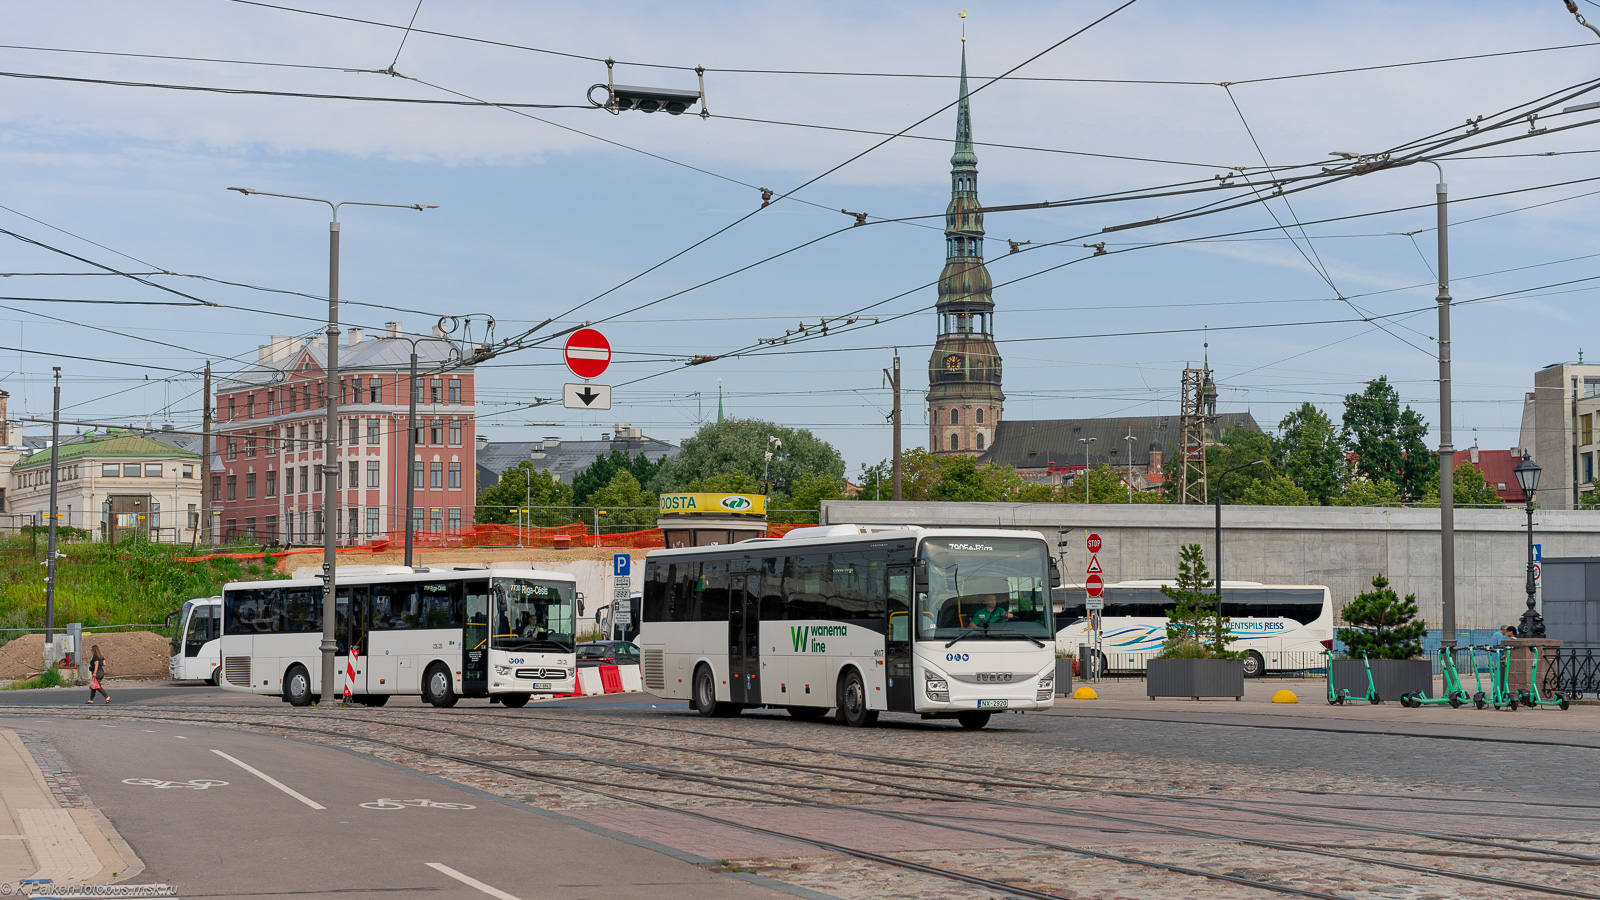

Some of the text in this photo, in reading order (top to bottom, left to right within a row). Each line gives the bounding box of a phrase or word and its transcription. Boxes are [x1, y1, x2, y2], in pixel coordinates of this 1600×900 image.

[660, 496, 697, 510] OOSTA
[1087, 539, 1101, 548] STOP
[617, 556, 627, 574] P
[810, 625, 847, 637] wanema
[1224, 621, 1285, 632] VENTSPILS REISS
[811, 638, 826, 653] line
[976, 673, 1012, 682] IVECO
[981, 700, 1007, 708] NX-2920
